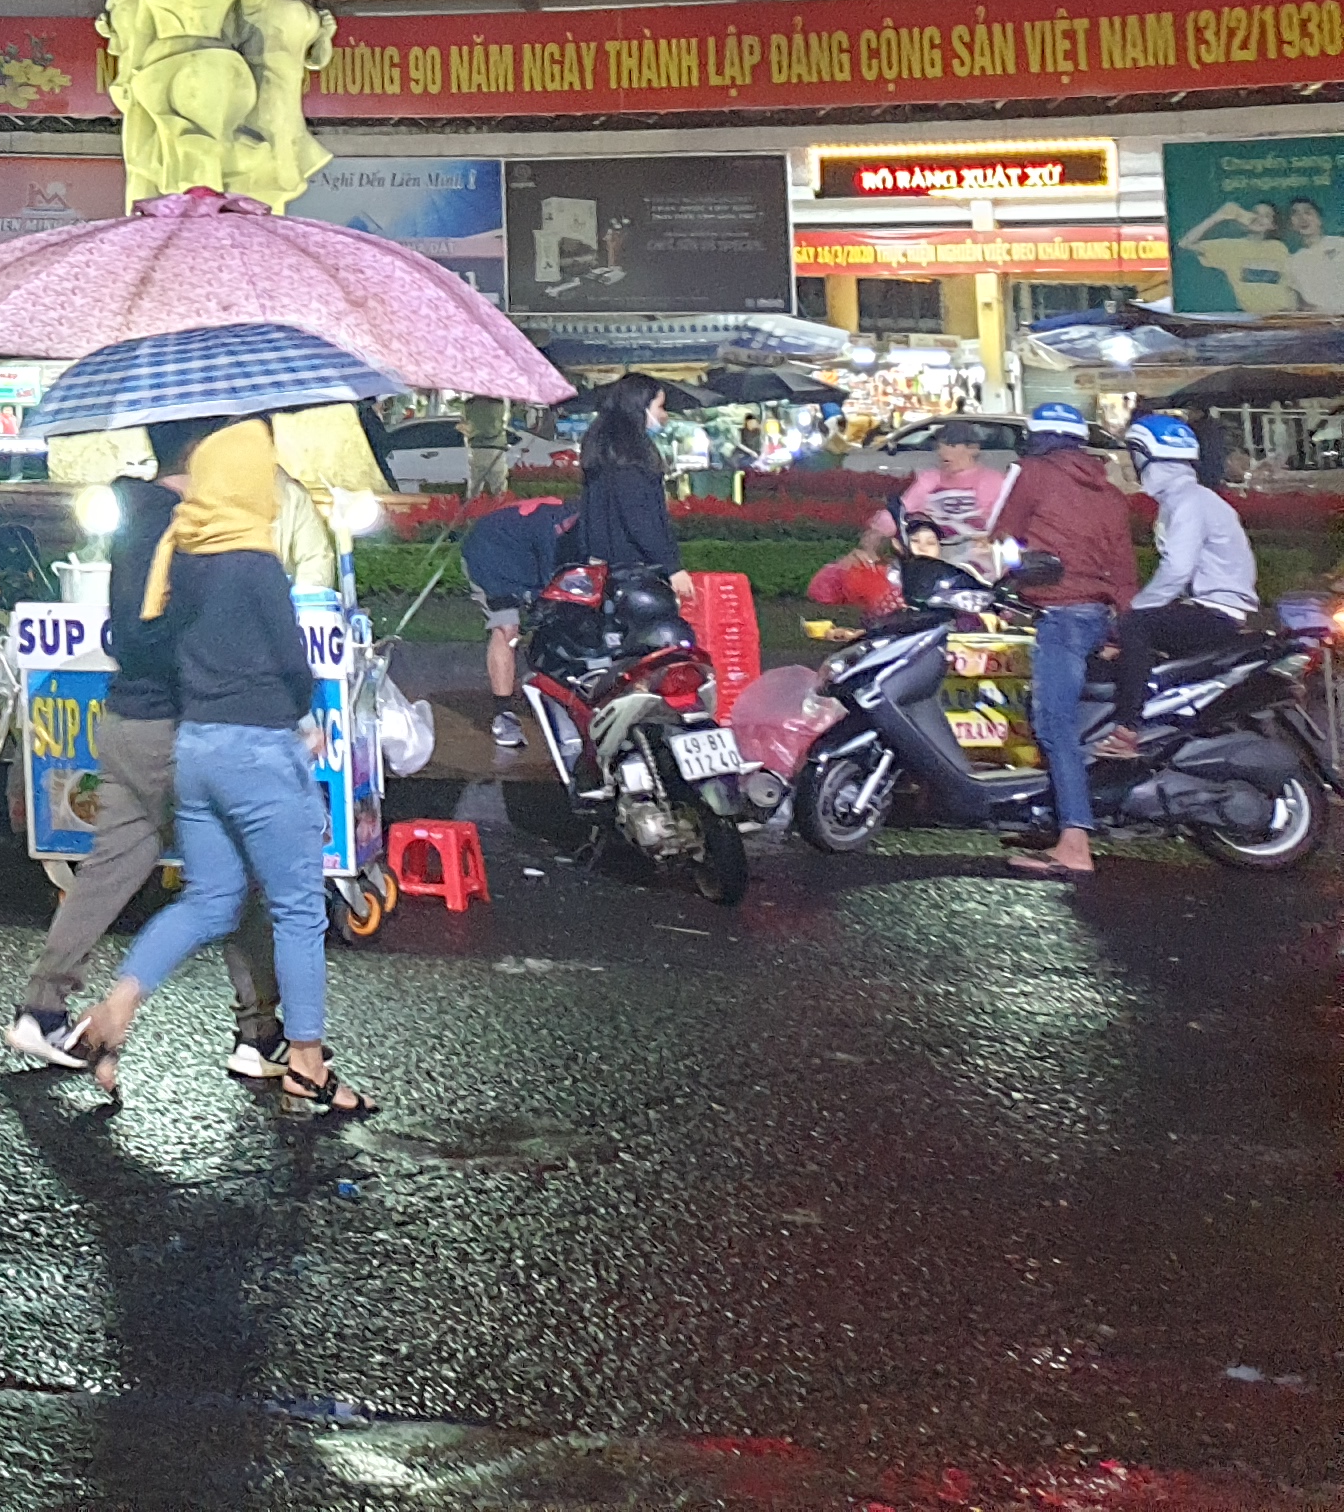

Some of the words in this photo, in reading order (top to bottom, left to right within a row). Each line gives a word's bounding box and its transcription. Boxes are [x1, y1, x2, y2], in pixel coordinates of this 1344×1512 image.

[320, 36, 401, 96] MỪNG
[409, 45, 442, 96] 90
[450, 34, 515, 94] NĂM
[523, 31, 598, 92] NGÀY
[605, 28, 698, 90] THÀNH
[706, 24, 762, 97] LẬP
[770, 16, 851, 85] ĐẢNG
[859, 17, 943, 92] CỘNG
[952, 6, 1017, 78] SẢN
[1024, 7, 1090, 85] VIỆT
[1099, 10, 1176, 71] NAM
[896, 167, 957, 189] RÀNG
[960, 165, 1021, 188] XUẤT
[18, 609, 85, 656] SÚP
[31, 679, 80, 759] SÚP
